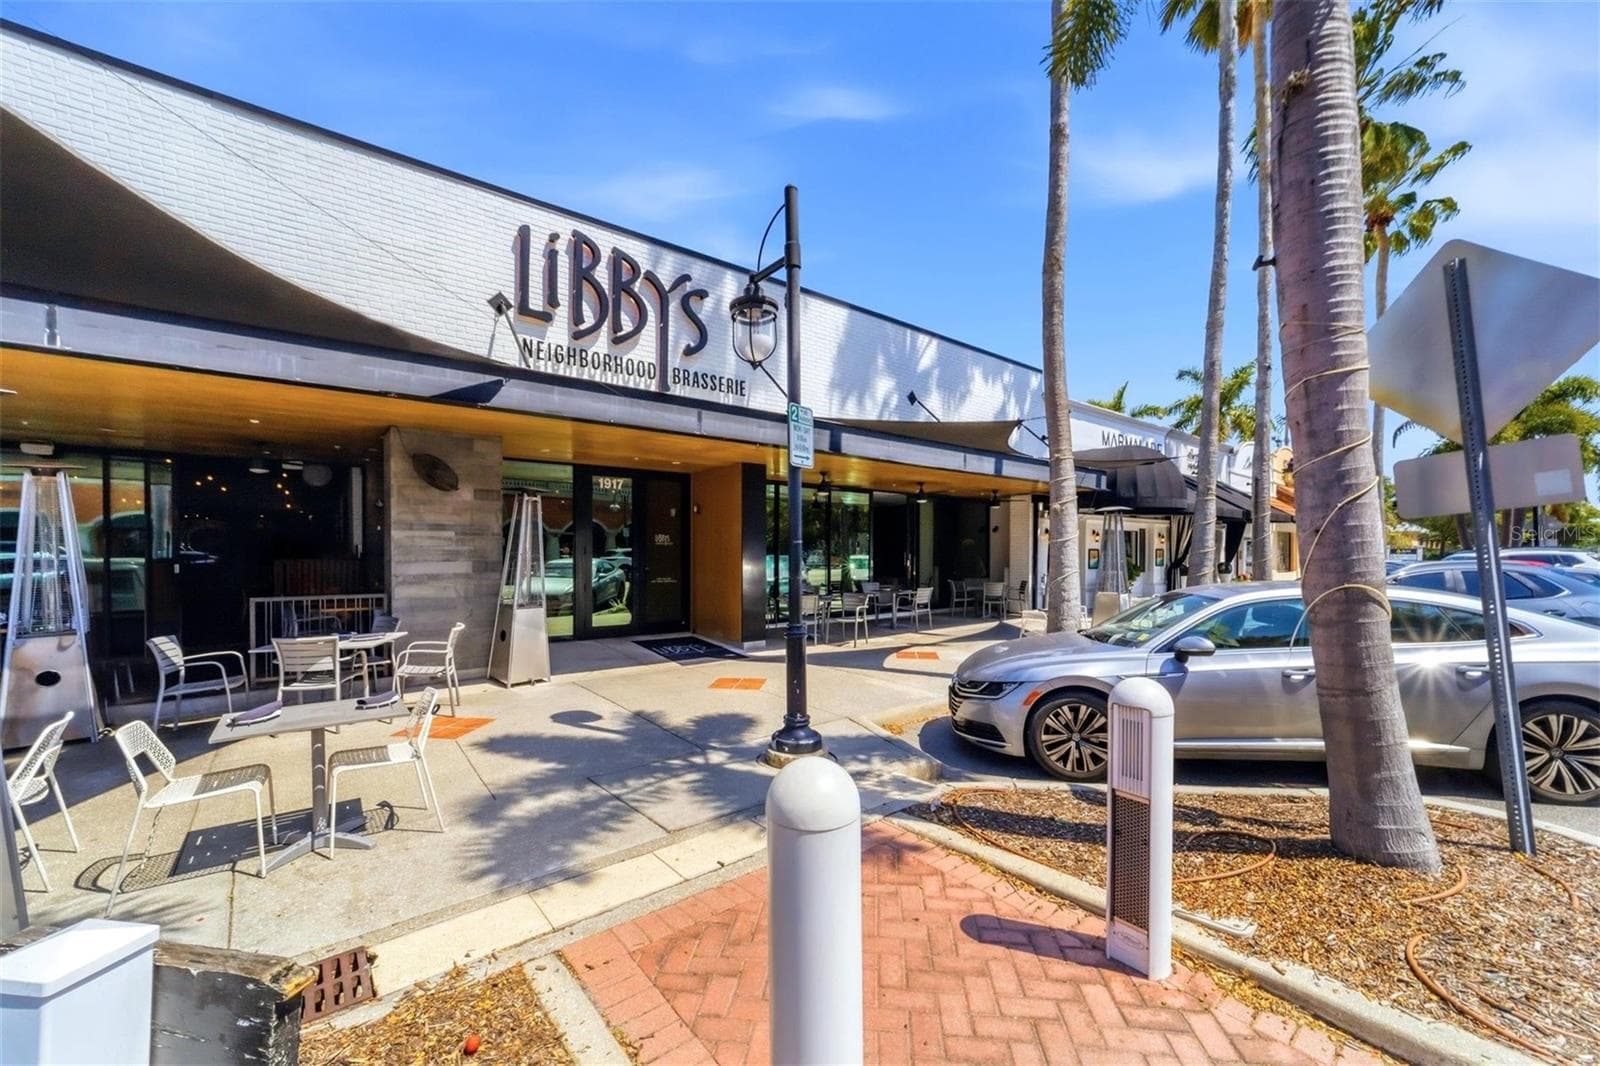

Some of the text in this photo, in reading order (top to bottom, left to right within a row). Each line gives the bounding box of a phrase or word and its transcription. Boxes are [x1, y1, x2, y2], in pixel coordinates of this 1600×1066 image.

[522, 337, 747, 397] NEIGHBORHOOD BRASSERIE
[791, 406, 798, 421] 2
[598, 477, 624, 490] 1917
